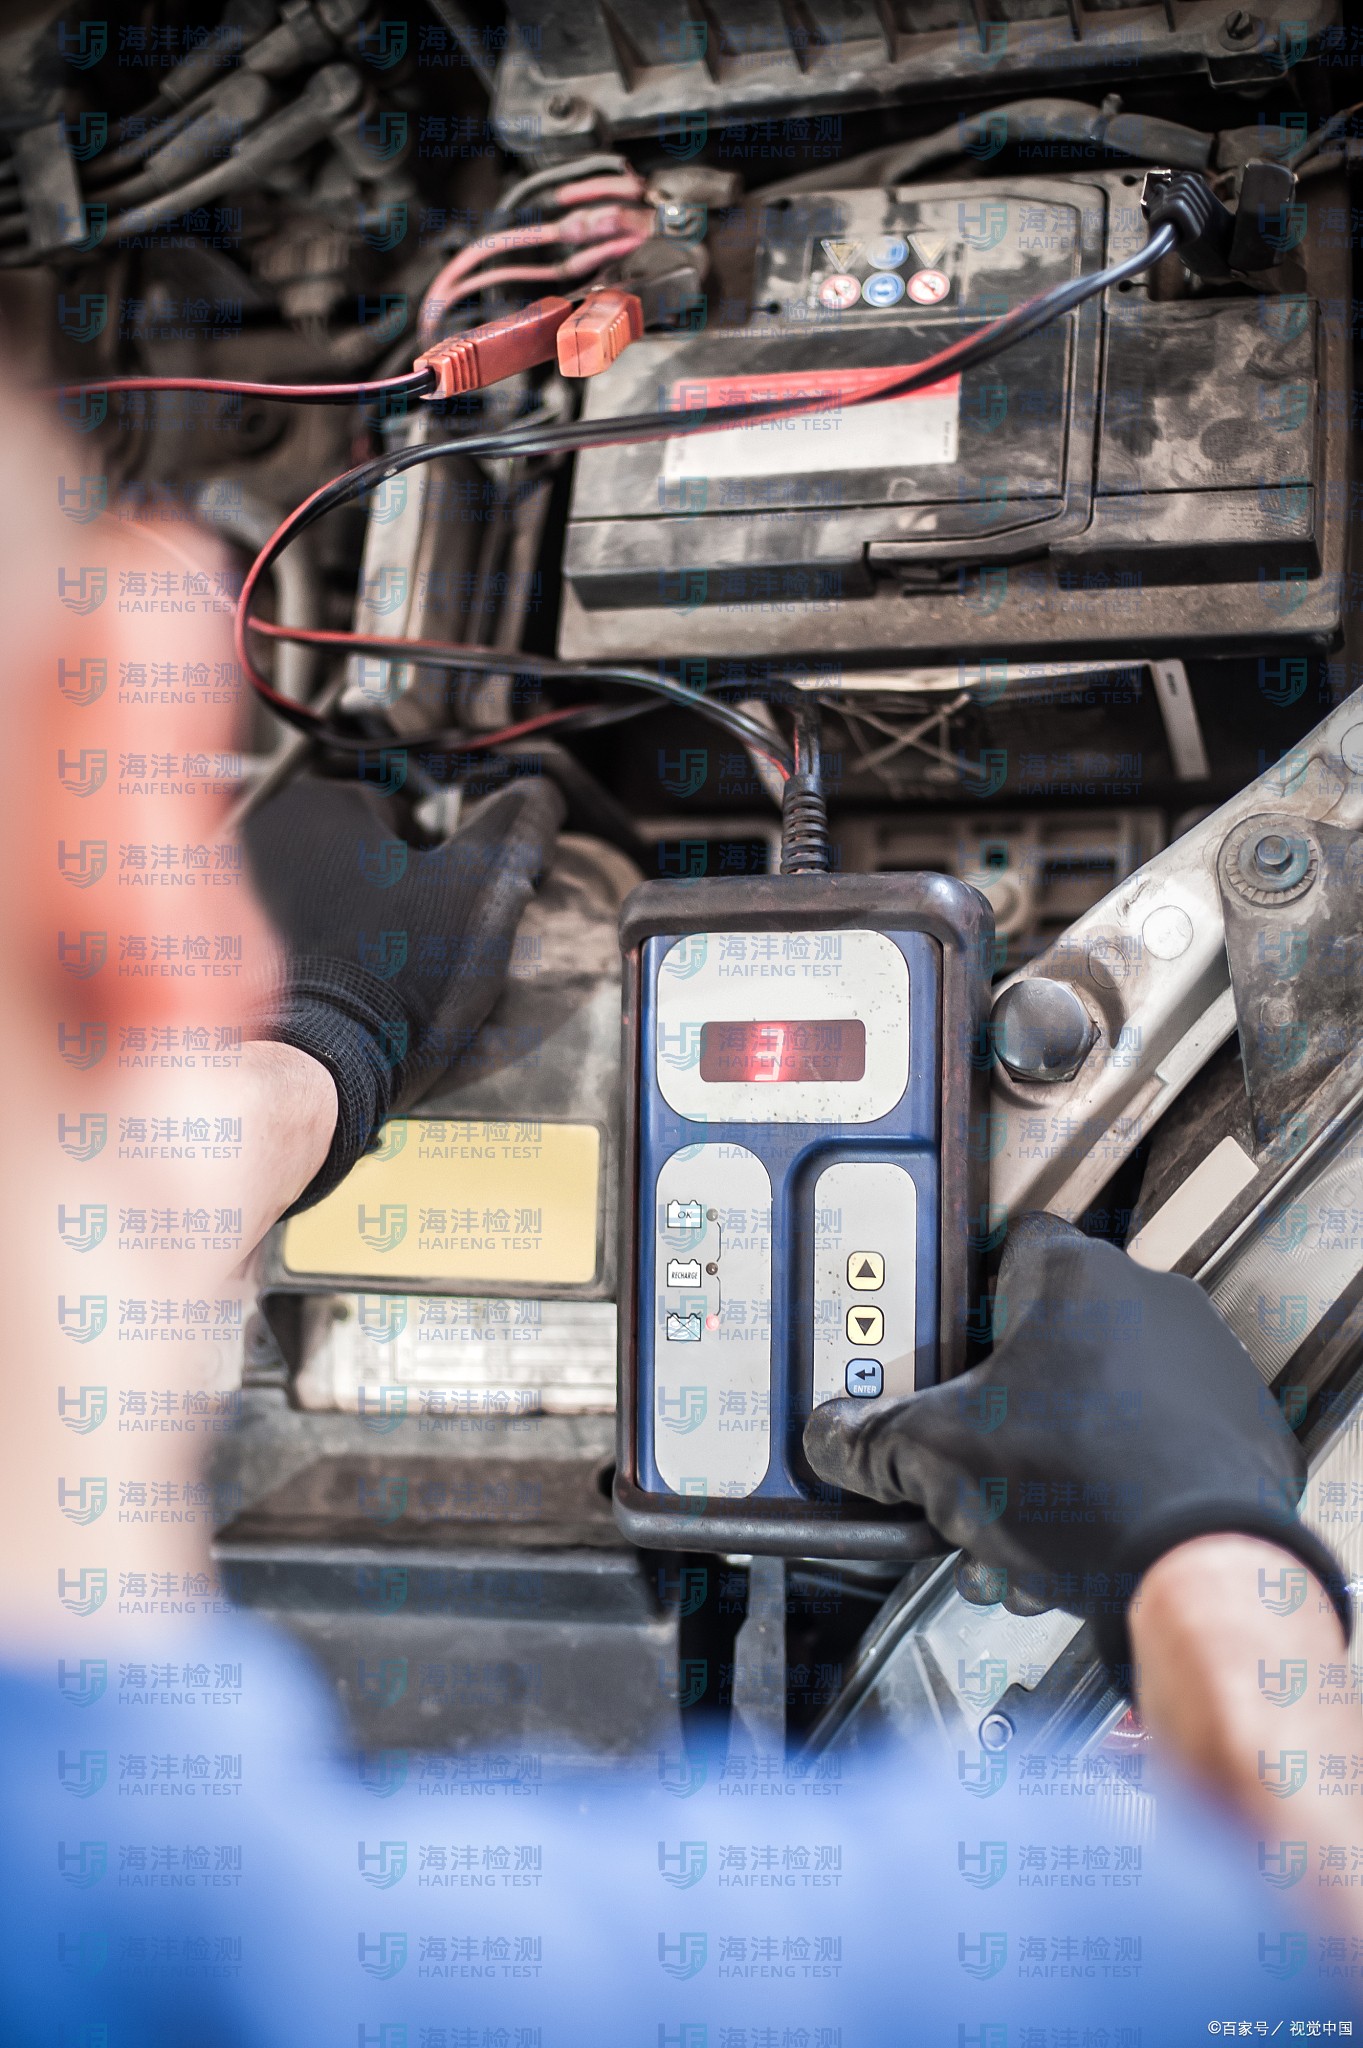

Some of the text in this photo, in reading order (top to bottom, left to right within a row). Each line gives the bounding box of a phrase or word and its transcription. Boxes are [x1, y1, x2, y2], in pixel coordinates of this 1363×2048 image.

[754, 1028, 785, 1081] 3
[677, 1211, 693, 1220] OK
[671, 1271, 698, 1280] RECHARGE
[853, 1384, 877, 1393] ENTER
